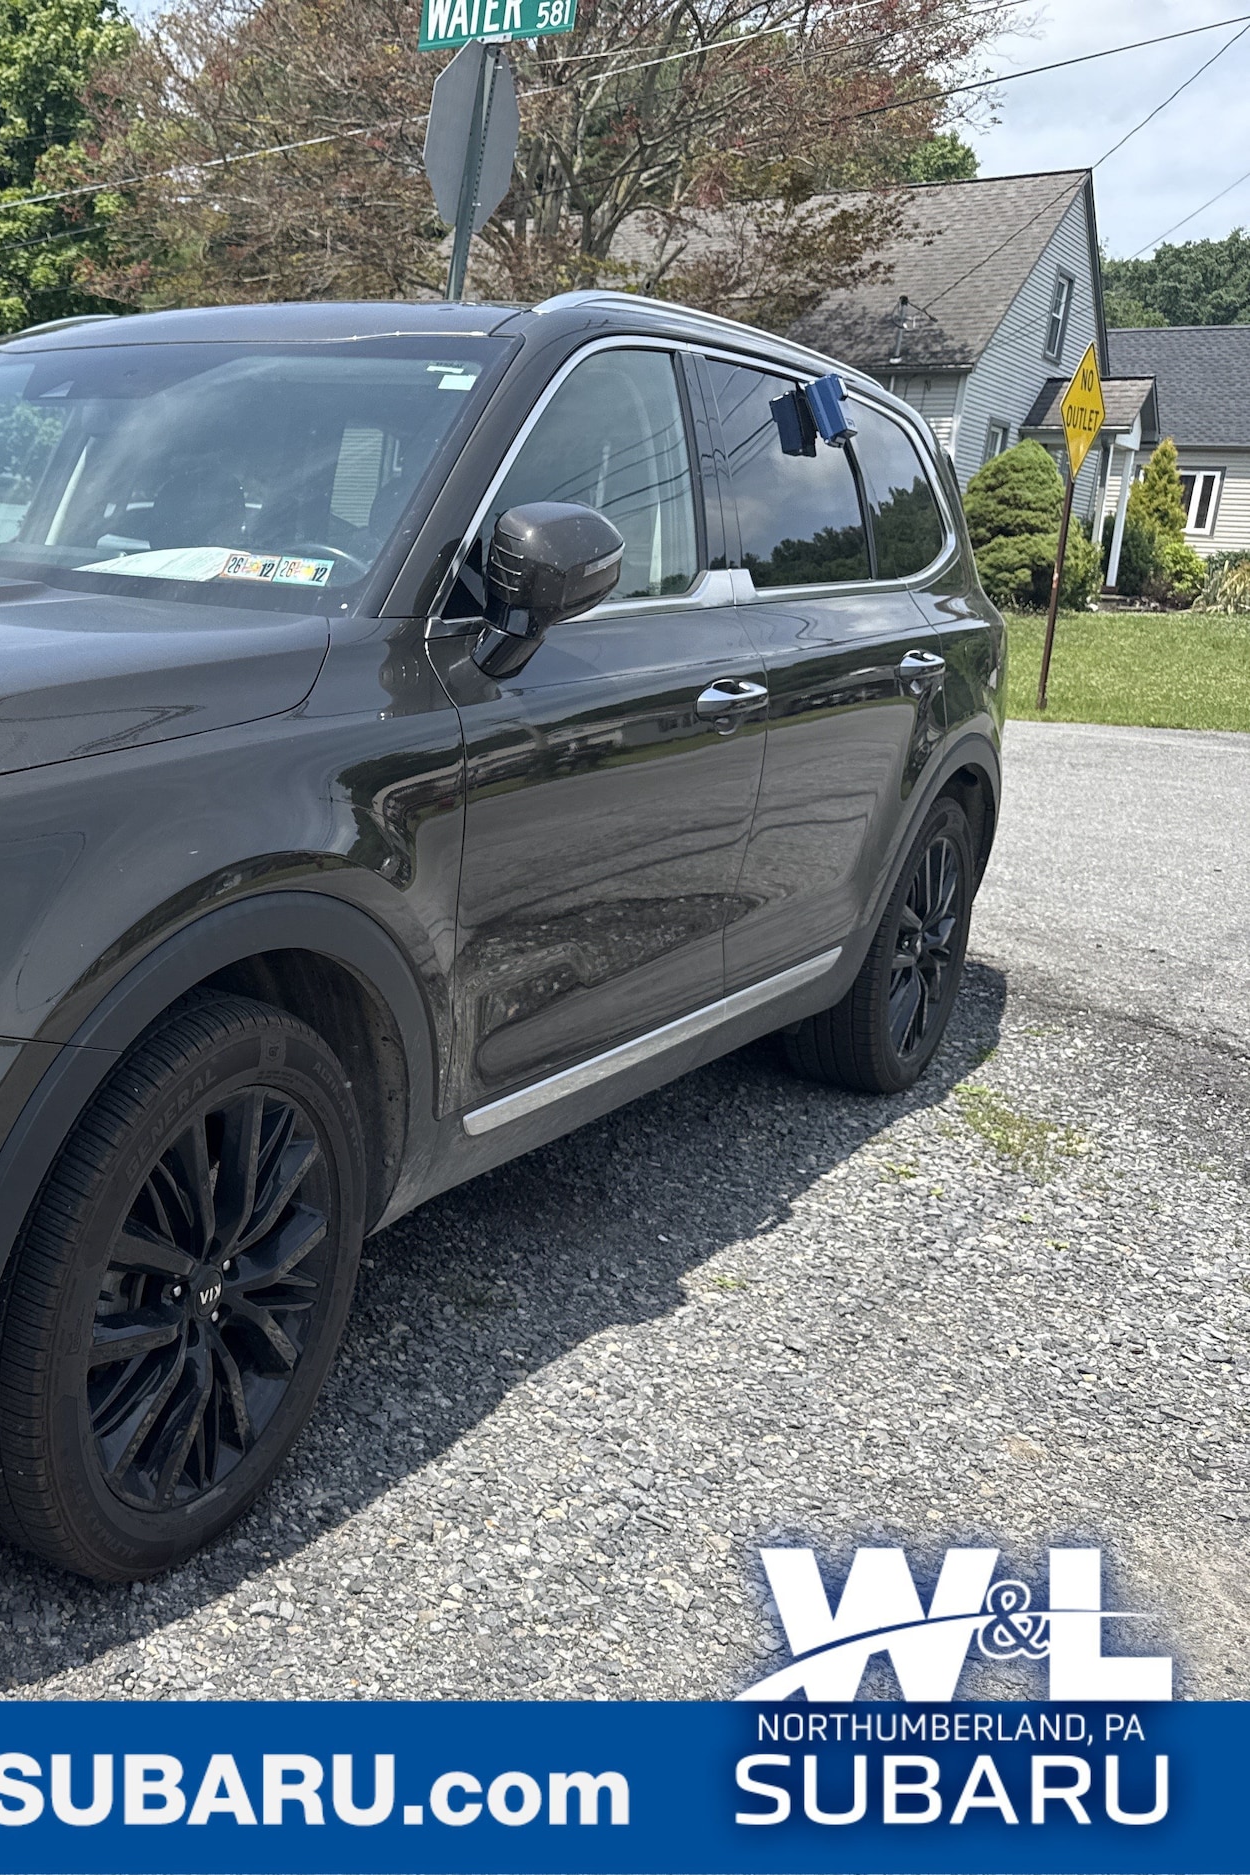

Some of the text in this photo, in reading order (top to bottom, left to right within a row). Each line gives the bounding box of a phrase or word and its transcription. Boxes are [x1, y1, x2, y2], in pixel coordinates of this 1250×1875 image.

[536, 0, 570, 29] 581
[1080, 367, 1094, 393] NO
[1066, 404, 1100, 432] OUTLET
[259, 562, 276, 578] 12
[312, 566, 328, 583] 12
[125, 1068, 218, 1183] GENERAL
[199, 1282, 222, 1305] KIA
